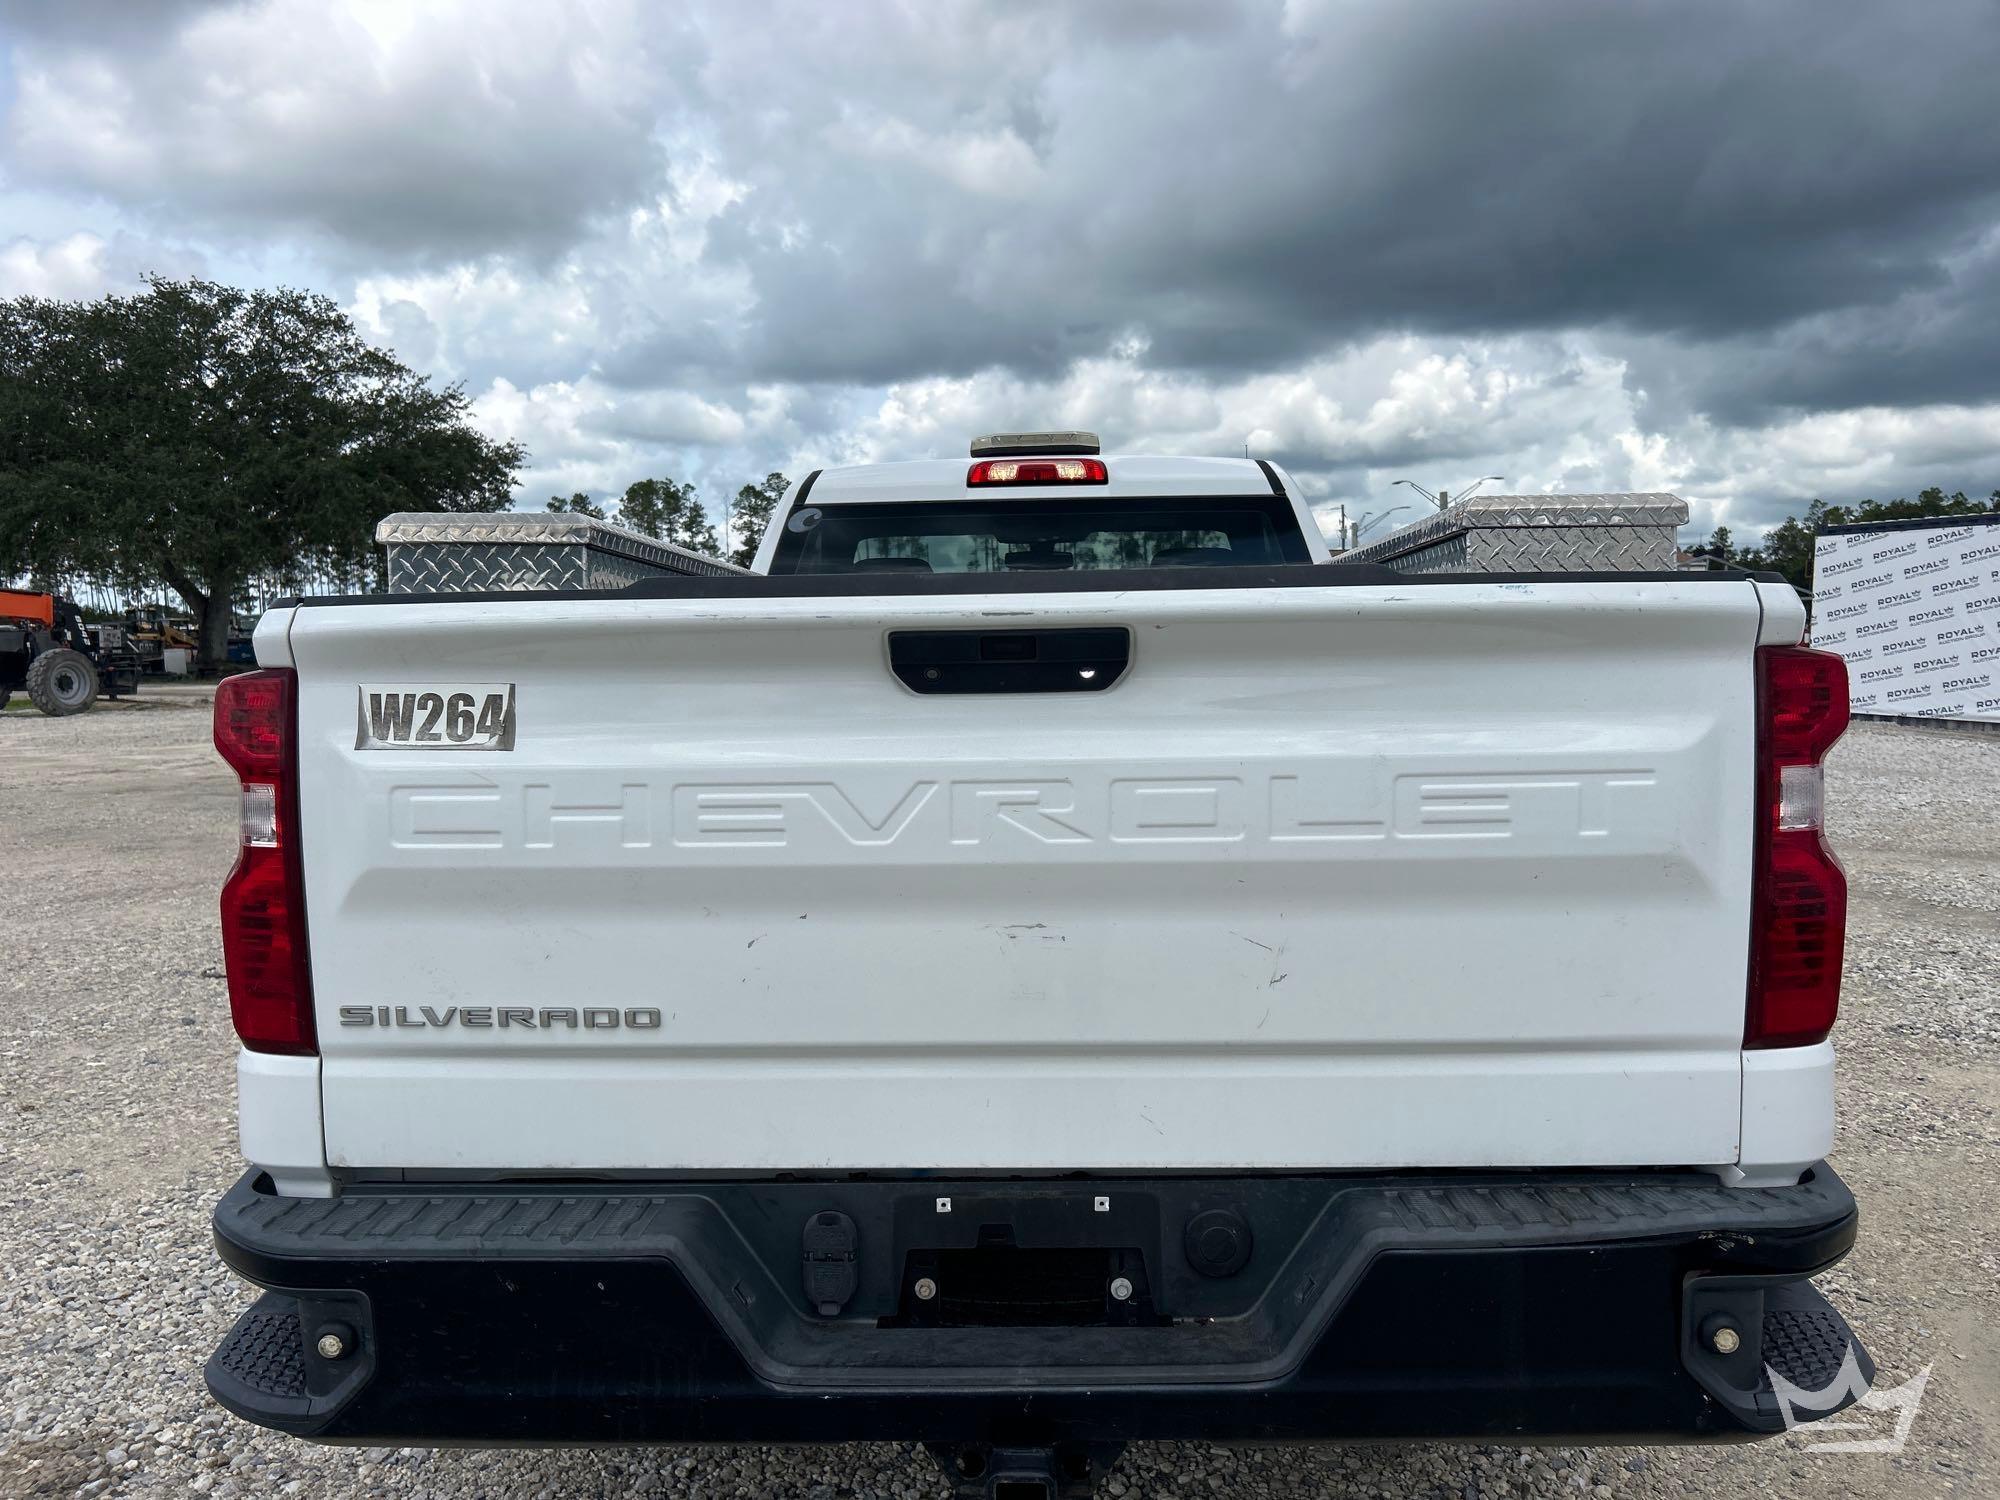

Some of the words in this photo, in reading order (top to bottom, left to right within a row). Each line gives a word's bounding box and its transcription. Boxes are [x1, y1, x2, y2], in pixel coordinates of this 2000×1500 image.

[1928, 530, 1964, 544] ROYAL
[1873, 546, 1907, 559] ROYAL
[1961, 546, 1998, 560] ROYAL
[1823, 561, 1854, 573] ROYAL
[1904, 562, 1939, 575] ROYAL
[1851, 576, 1884, 589] ROYAL
[1932, 579, 1969, 592] ROYAL
[1813, 589, 1833, 599] YAL
[1878, 593, 1912, 605] ROYAL
[1827, 605, 1859, 617] ROYAL
[1909, 610, 1944, 622] ROYAL
[1856, 622, 1889, 634] ROYAL
[1938, 628, 1974, 640] ROYAL
[1882, 640, 1917, 651] ROYAL
[1842, 651, 1864, 660] YAL
[1971, 648, 2000, 658] ROYA
[1914, 658, 1949, 669] ROYAL
[1861, 669, 1894, 679] ROYAL
[1943, 678, 1980, 688] ROYAL
[1887, 687, 1921, 697] ROYAL
[1850, 696, 1867, 704] YAL
[1976, 698, 2000, 708] ROY
[369, 692, 505, 742] W264
[1918, 706, 1954, 716] ROYAL
[388, 767, 1658, 848] CHEVROLET
[339, 1004, 661, 1029] SILVERADO
